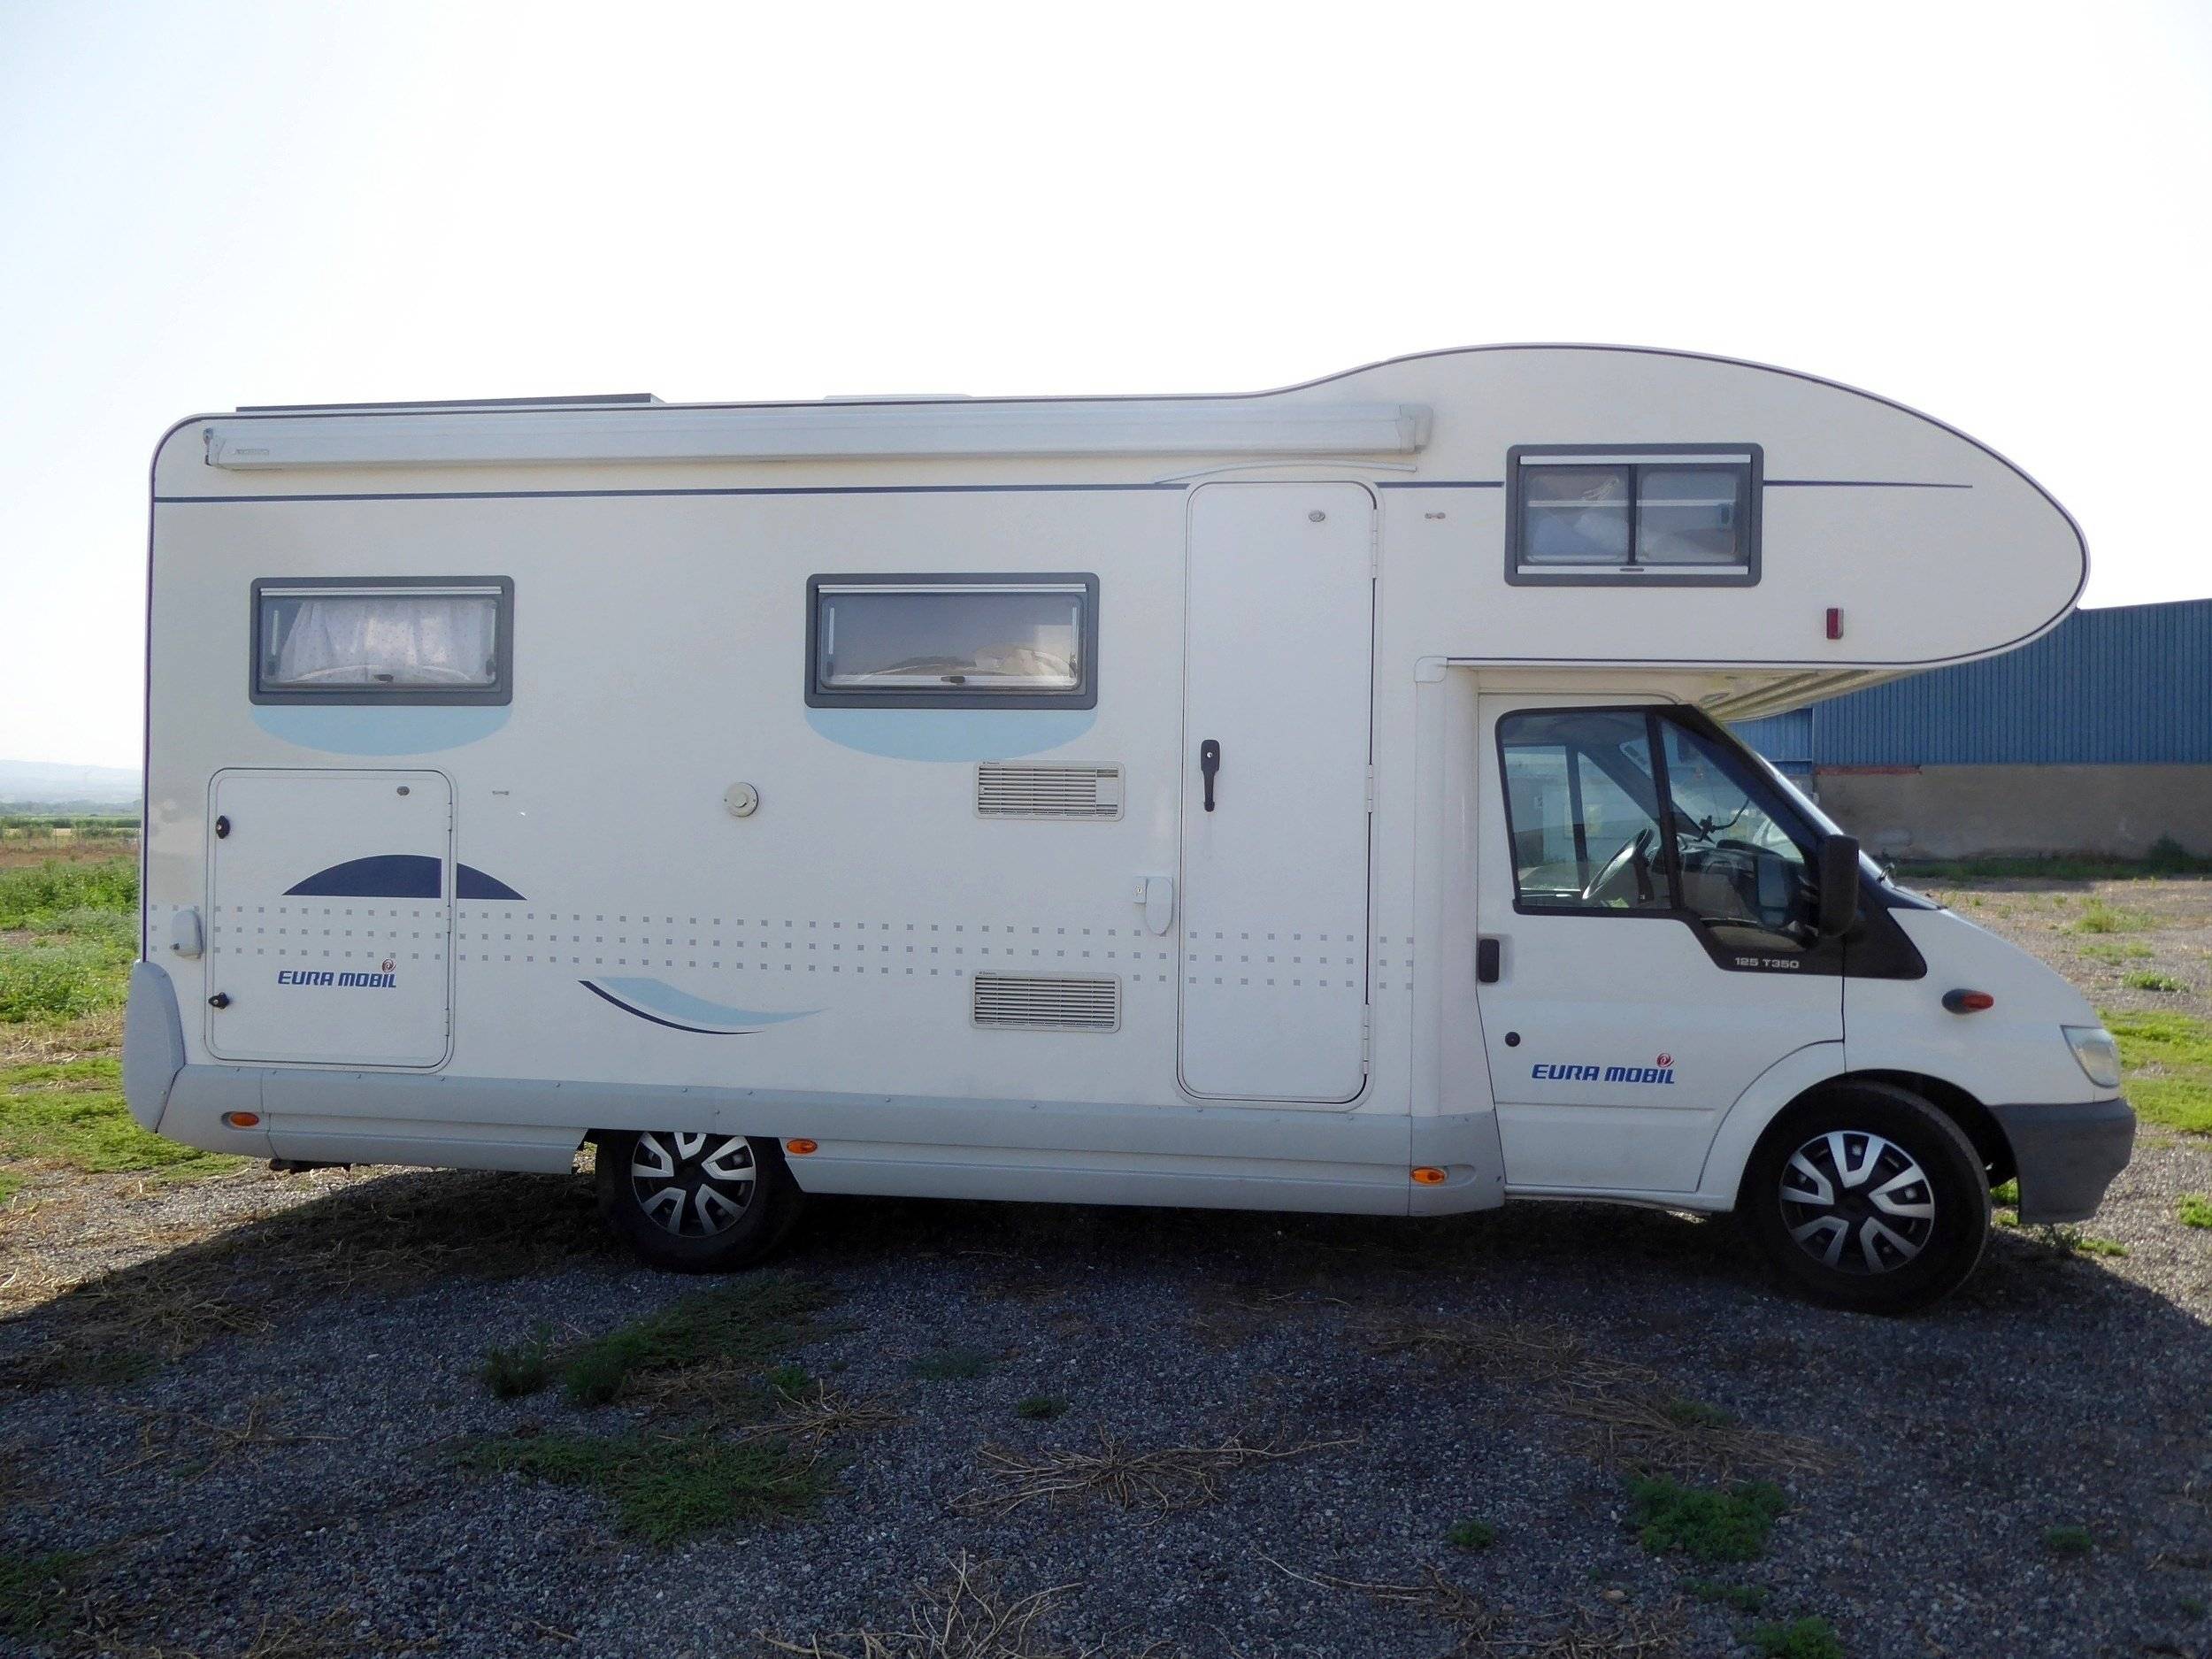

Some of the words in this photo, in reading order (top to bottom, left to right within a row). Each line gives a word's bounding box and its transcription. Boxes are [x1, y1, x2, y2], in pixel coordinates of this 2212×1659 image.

[1734, 957, 1759, 967] 125
[1763, 958, 1800, 969] T350
[278, 970, 334, 987] EURA
[338, 972, 397, 988] MOBIL
[1532, 1064, 1601, 1081] EURA
[1604, 1066, 1675, 1085] MOBIL
